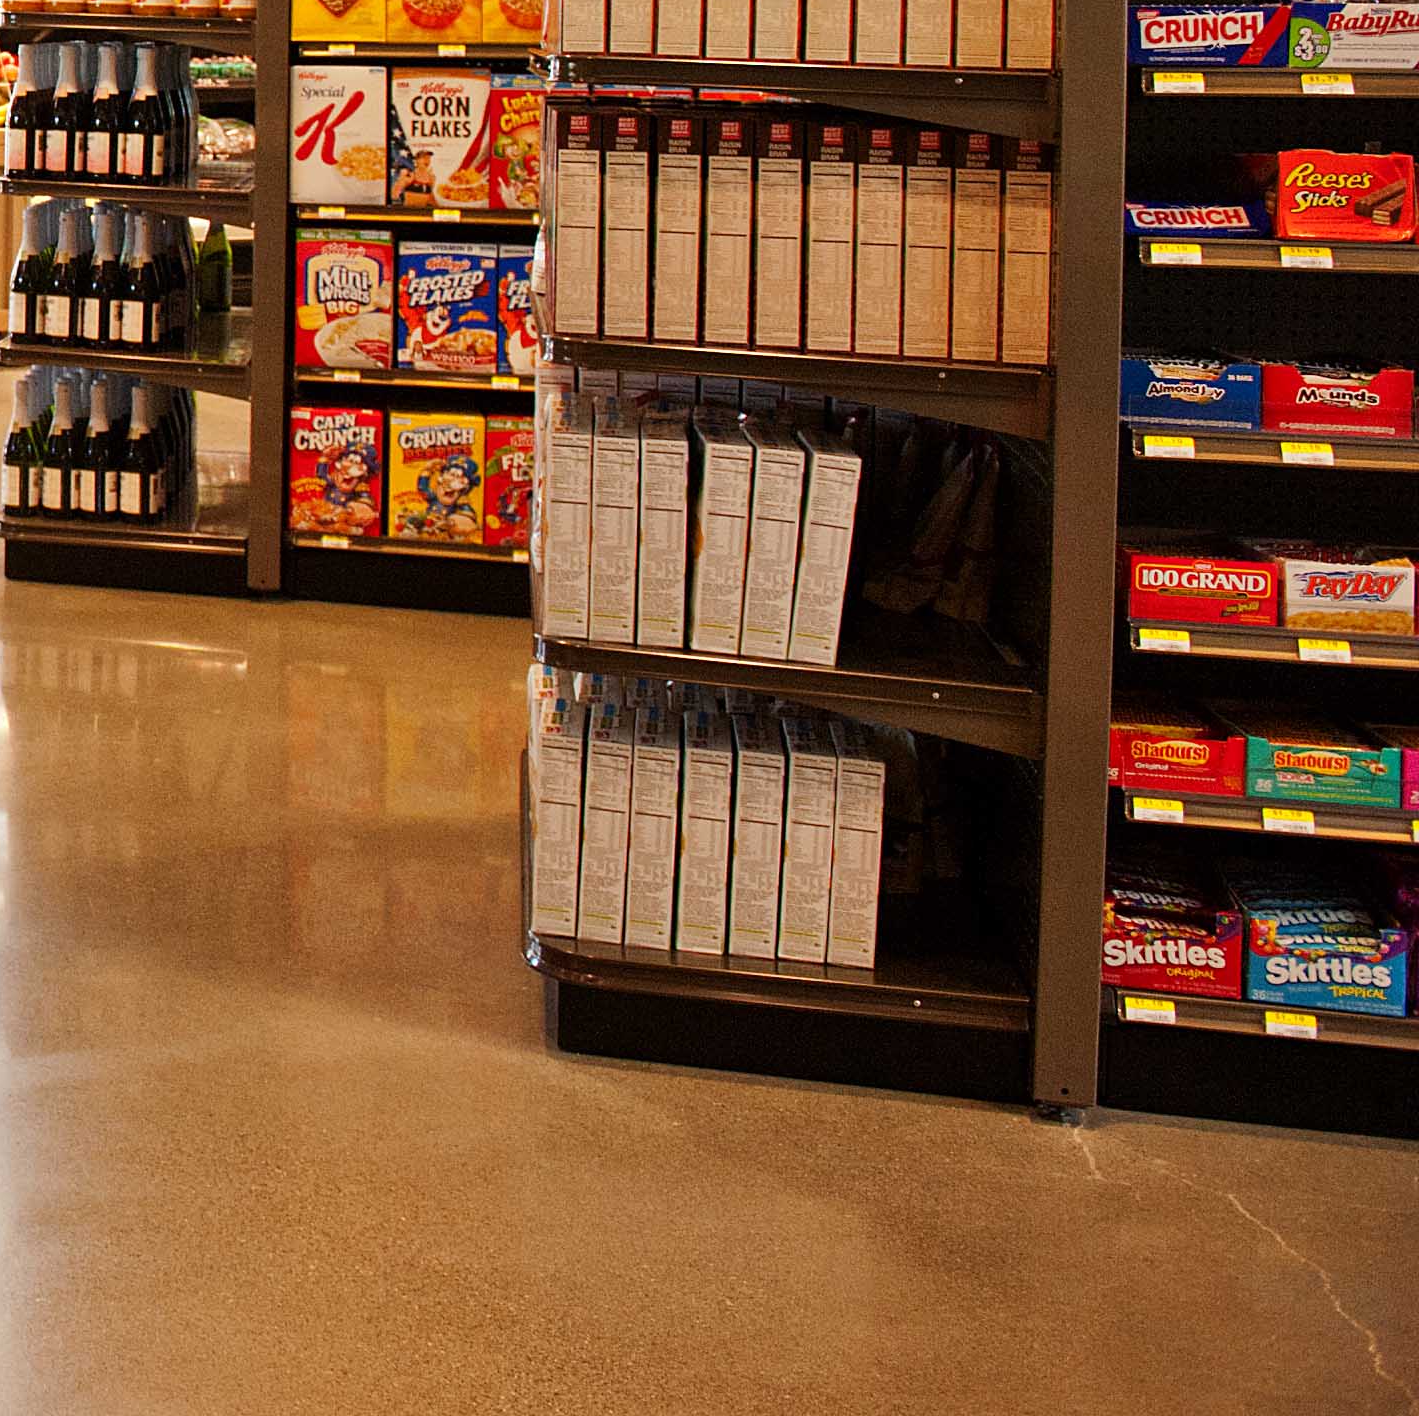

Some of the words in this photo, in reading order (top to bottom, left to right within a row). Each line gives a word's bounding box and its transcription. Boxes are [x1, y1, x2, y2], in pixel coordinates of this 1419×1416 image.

[1144, 15, 1261, 44] CRUNCH
[299, 85, 346, 100] Special
[420, 83, 464, 97] Kellogg's
[410, 95, 470, 117] CORN
[294, 90, 365, 165] K
[410, 120, 472, 138] FLAKES
[1285, 162, 1374, 190] Reese's
[1290, 191, 1350, 213] Sticks
[1136, 209, 1244, 226] CRUNCH
[318, 267, 373, 288] Mini-
[409, 271, 486, 293] FROSTED
[318, 284, 371, 305] Wheats
[410, 286, 475, 307] FLAKES
[325, 300, 361, 315] BIG
[1147, 382, 1200, 396] Almond
[1295, 387, 1380, 405] Munds
[313, 413, 356, 430] CAP'N
[294, 427, 377, 451] CRUNCH
[398, 428, 475, 449] CRUNCH
[1141, 568, 1180, 586] 100
[1181, 571, 1267, 592] GRAND
[1302, 573, 1407, 598] PayDay
[1131, 740, 1210, 764] Starburst
[1274, 750, 1351, 774] Starburst
[1104, 940, 1225, 969] Skittles
[1266, 957, 1392, 988] Skittles
[1328, 985, 1388, 1000] TROPICAL
